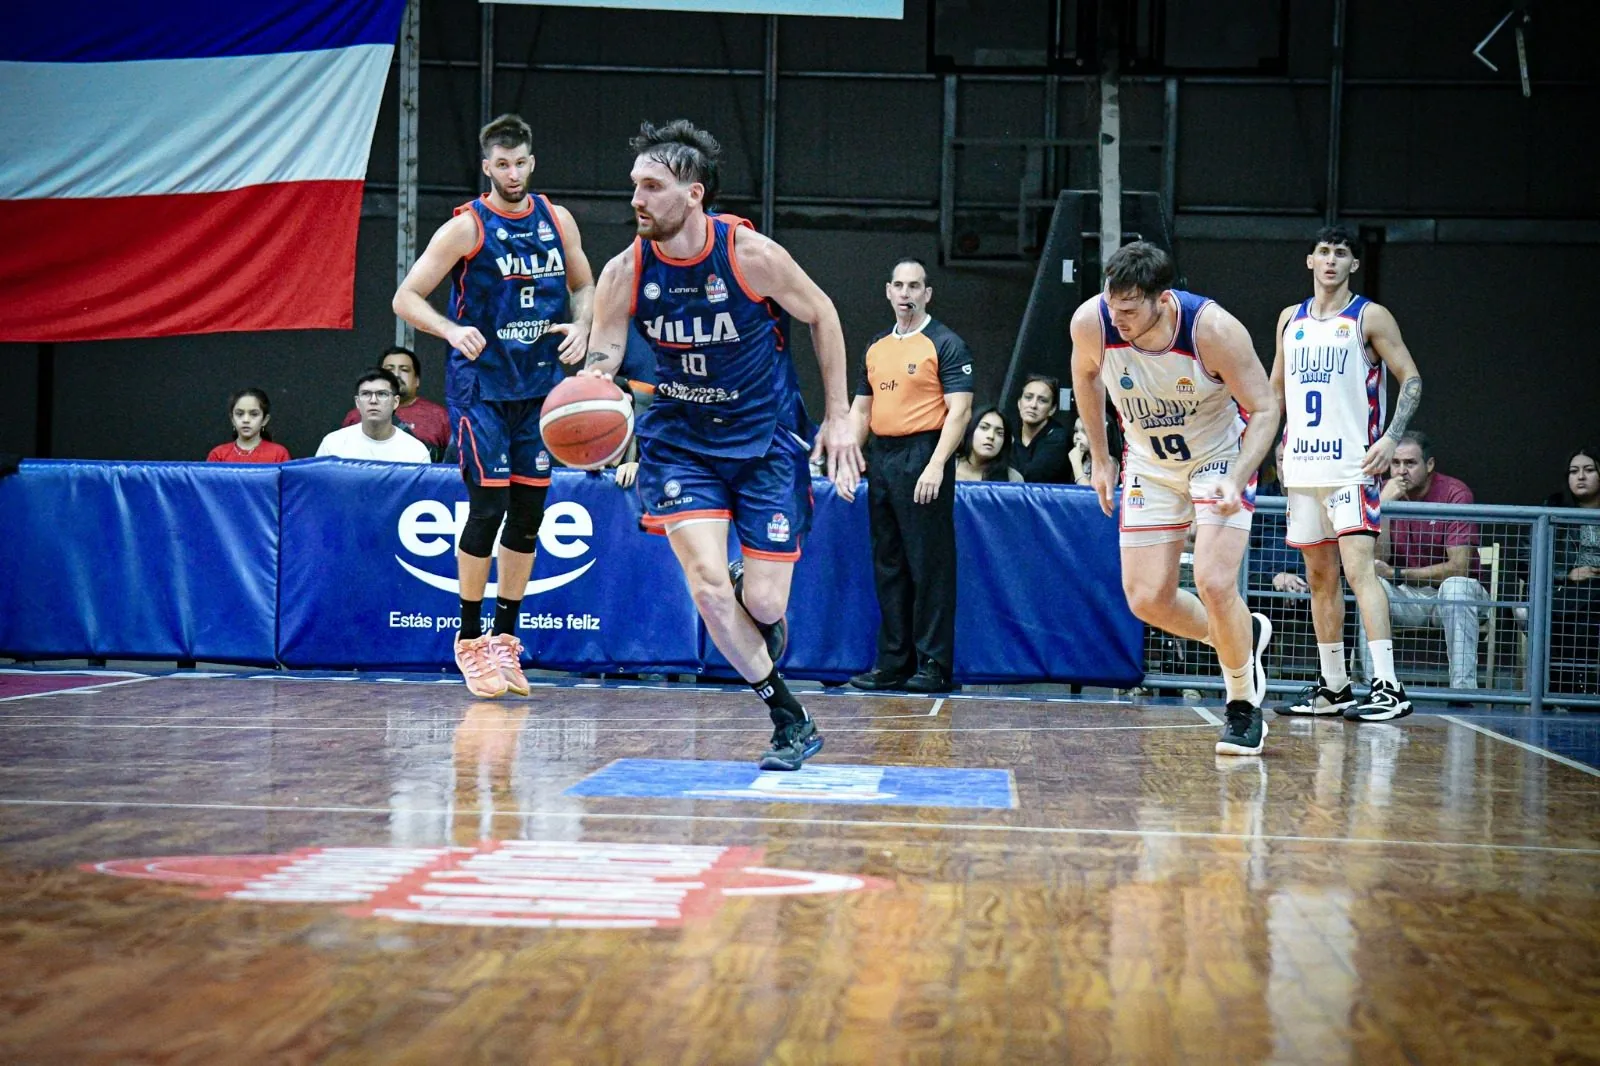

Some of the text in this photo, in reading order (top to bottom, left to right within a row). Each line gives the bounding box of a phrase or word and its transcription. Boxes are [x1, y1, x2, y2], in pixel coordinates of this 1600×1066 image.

[496, 247, 564, 276] VILLA
[520, 286, 535, 309] 8
[643, 312, 739, 343] VILLA
[681, 353, 707, 376] 10
[1290, 345, 1348, 376] JUJUY
[1120, 396, 1200, 424] JUJUY
[1305, 390, 1322, 428] 9
[1149, 434, 1191, 461] 19
[389, 611, 433, 628] Estás
[519, 613, 564, 630] Estás
[566, 613, 600, 631] feliz
[758, 685, 775, 700] 10
